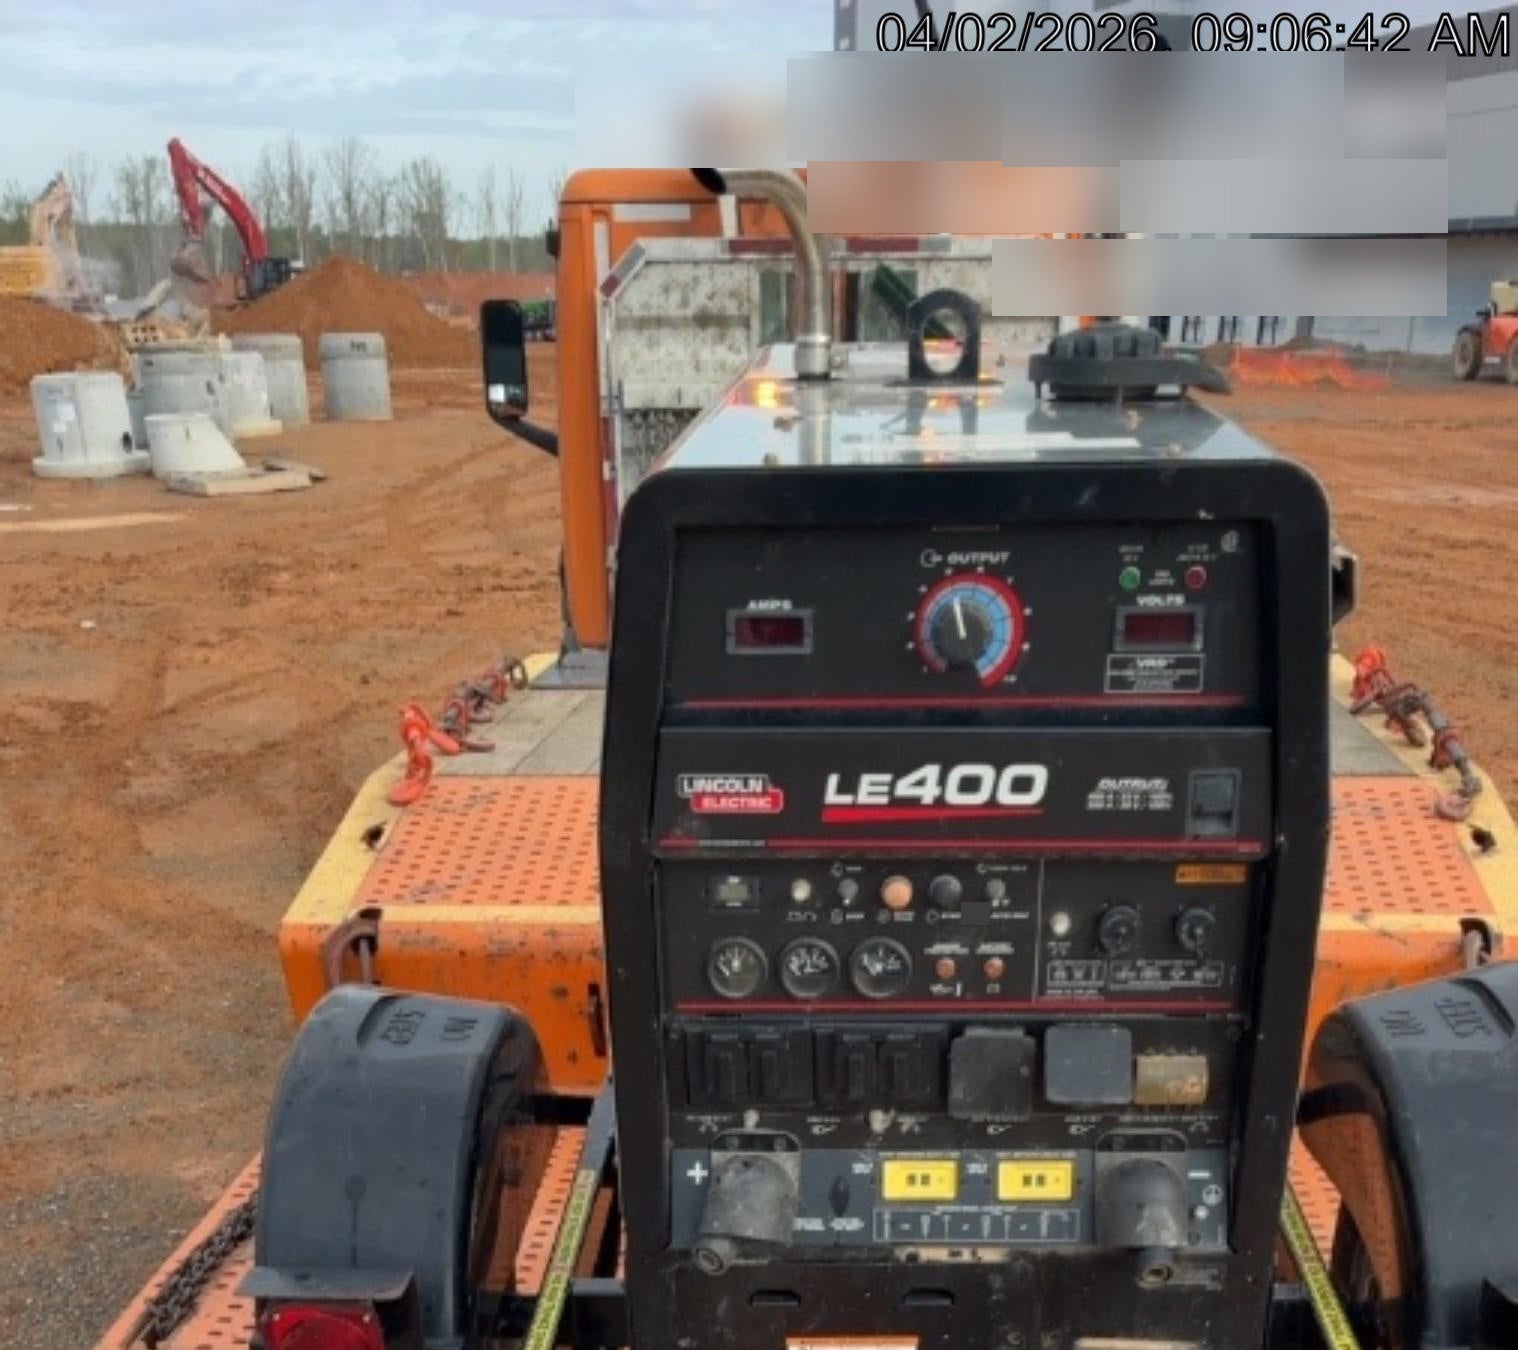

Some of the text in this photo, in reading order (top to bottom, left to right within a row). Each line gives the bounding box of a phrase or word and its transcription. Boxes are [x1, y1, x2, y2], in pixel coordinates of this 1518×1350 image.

[947, 551, 1011, 565] OUTPUT
[746, 599, 793, 610] AMPS
[1136, 594, 1186, 607] VOLTS
[682, 777, 763, 794] LINCOLN
[824, 764, 1049, 806] LE400
[700, 796, 773, 809] ELECTRIC
